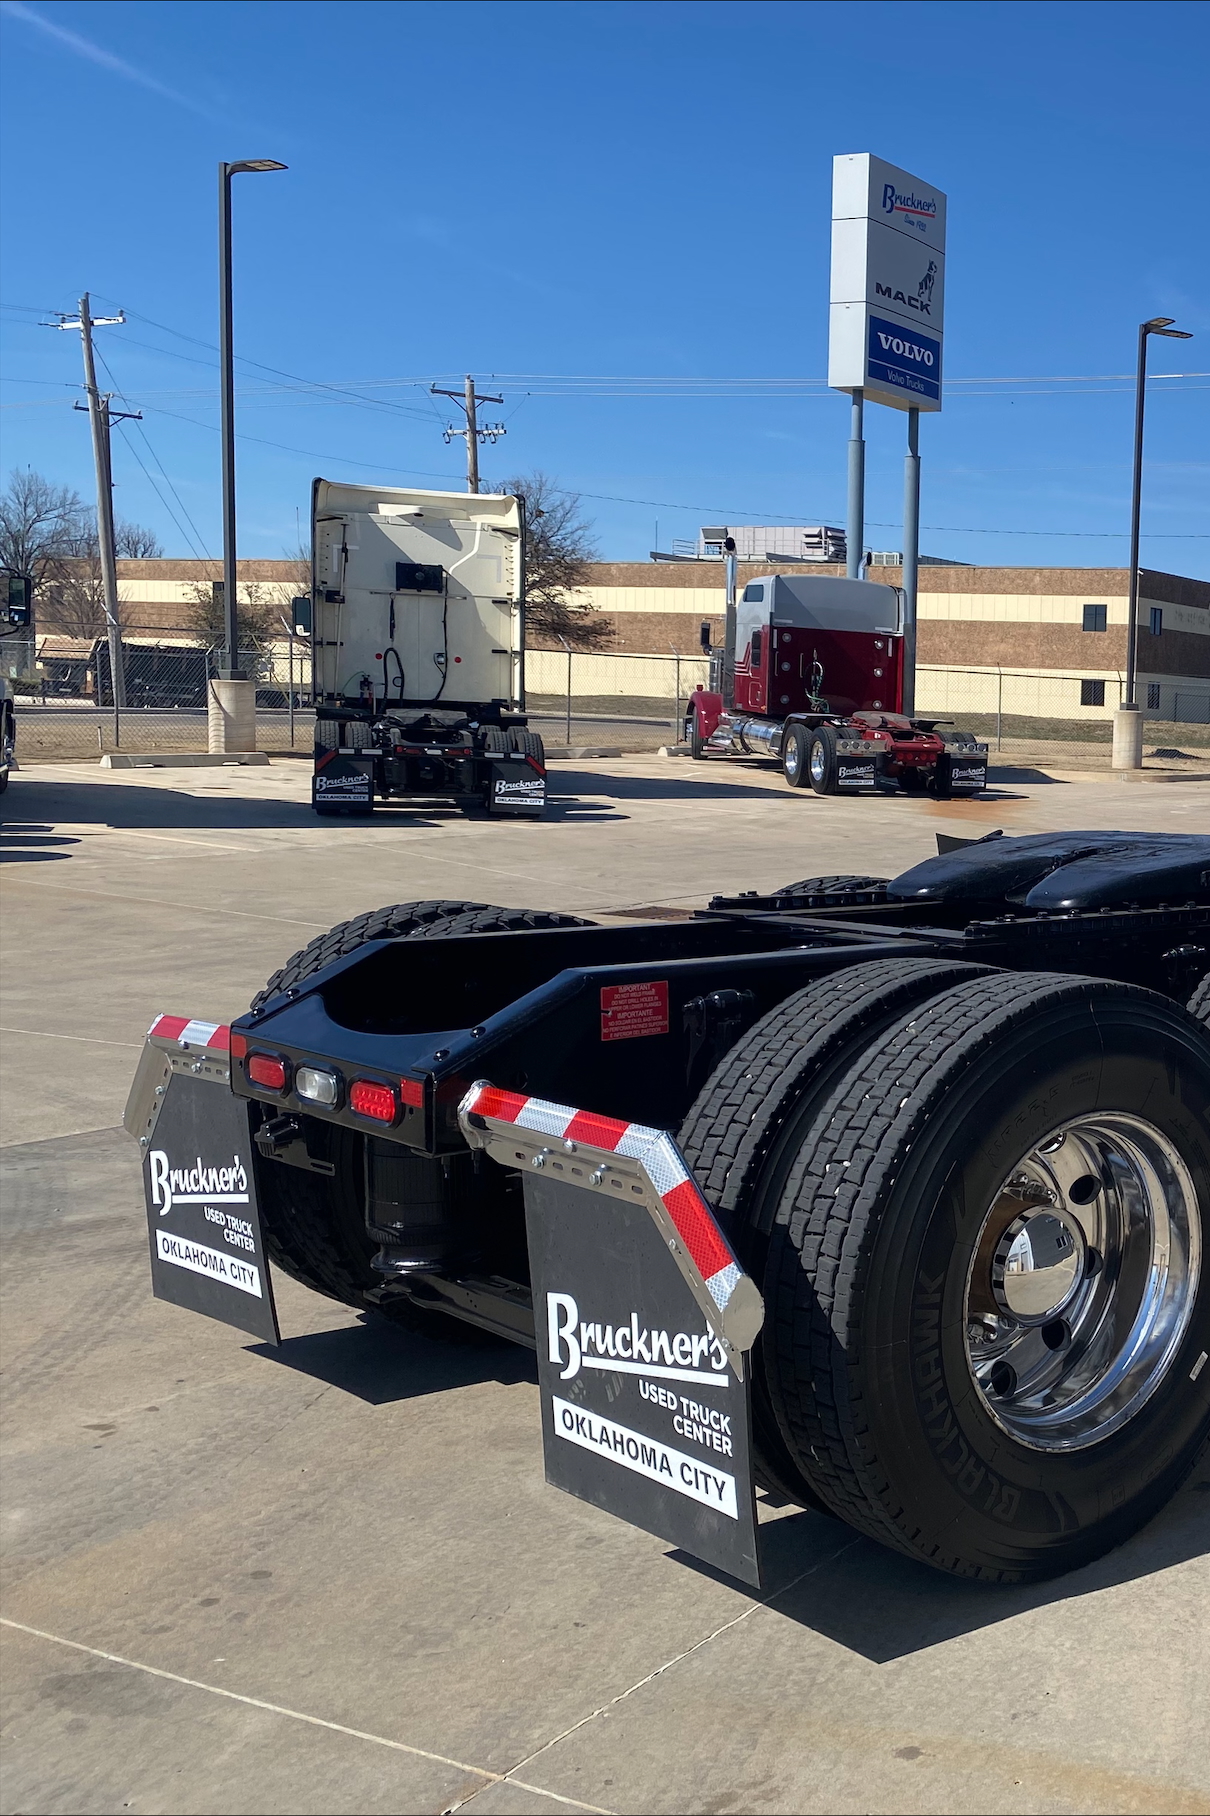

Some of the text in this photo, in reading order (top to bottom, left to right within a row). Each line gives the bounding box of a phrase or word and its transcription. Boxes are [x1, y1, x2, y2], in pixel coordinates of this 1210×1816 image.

[882, 184, 937, 214] Bruckner's
[875, 281, 931, 316] MACK
[877, 332, 934, 367] VOLVO
[887, 369, 925, 392] Volvo Trucks
[315, 773, 369, 792] Bruckner's
[494, 778, 546, 795] Bruckner's
[618, 983, 651, 993] IMPORTANT
[617, 1009, 654, 1019] IMPORTANTE
[150, 1150, 248, 1216] Bruckner's
[204, 1206, 254, 1238] USED TRUCK
[223, 1228, 256, 1253] CENTER
[161, 1237, 254, 1287] OKLAHOMA CITY
[547, 1292, 728, 1380] Bruckner's
[638, 1379, 732, 1436] USED TRUCK
[912, 1269, 1021, 1523] BLACKHAWK
[673, 1415, 733, 1458] CENTER
[562, 1408, 726, 1501] OKLAHOMA CITY
